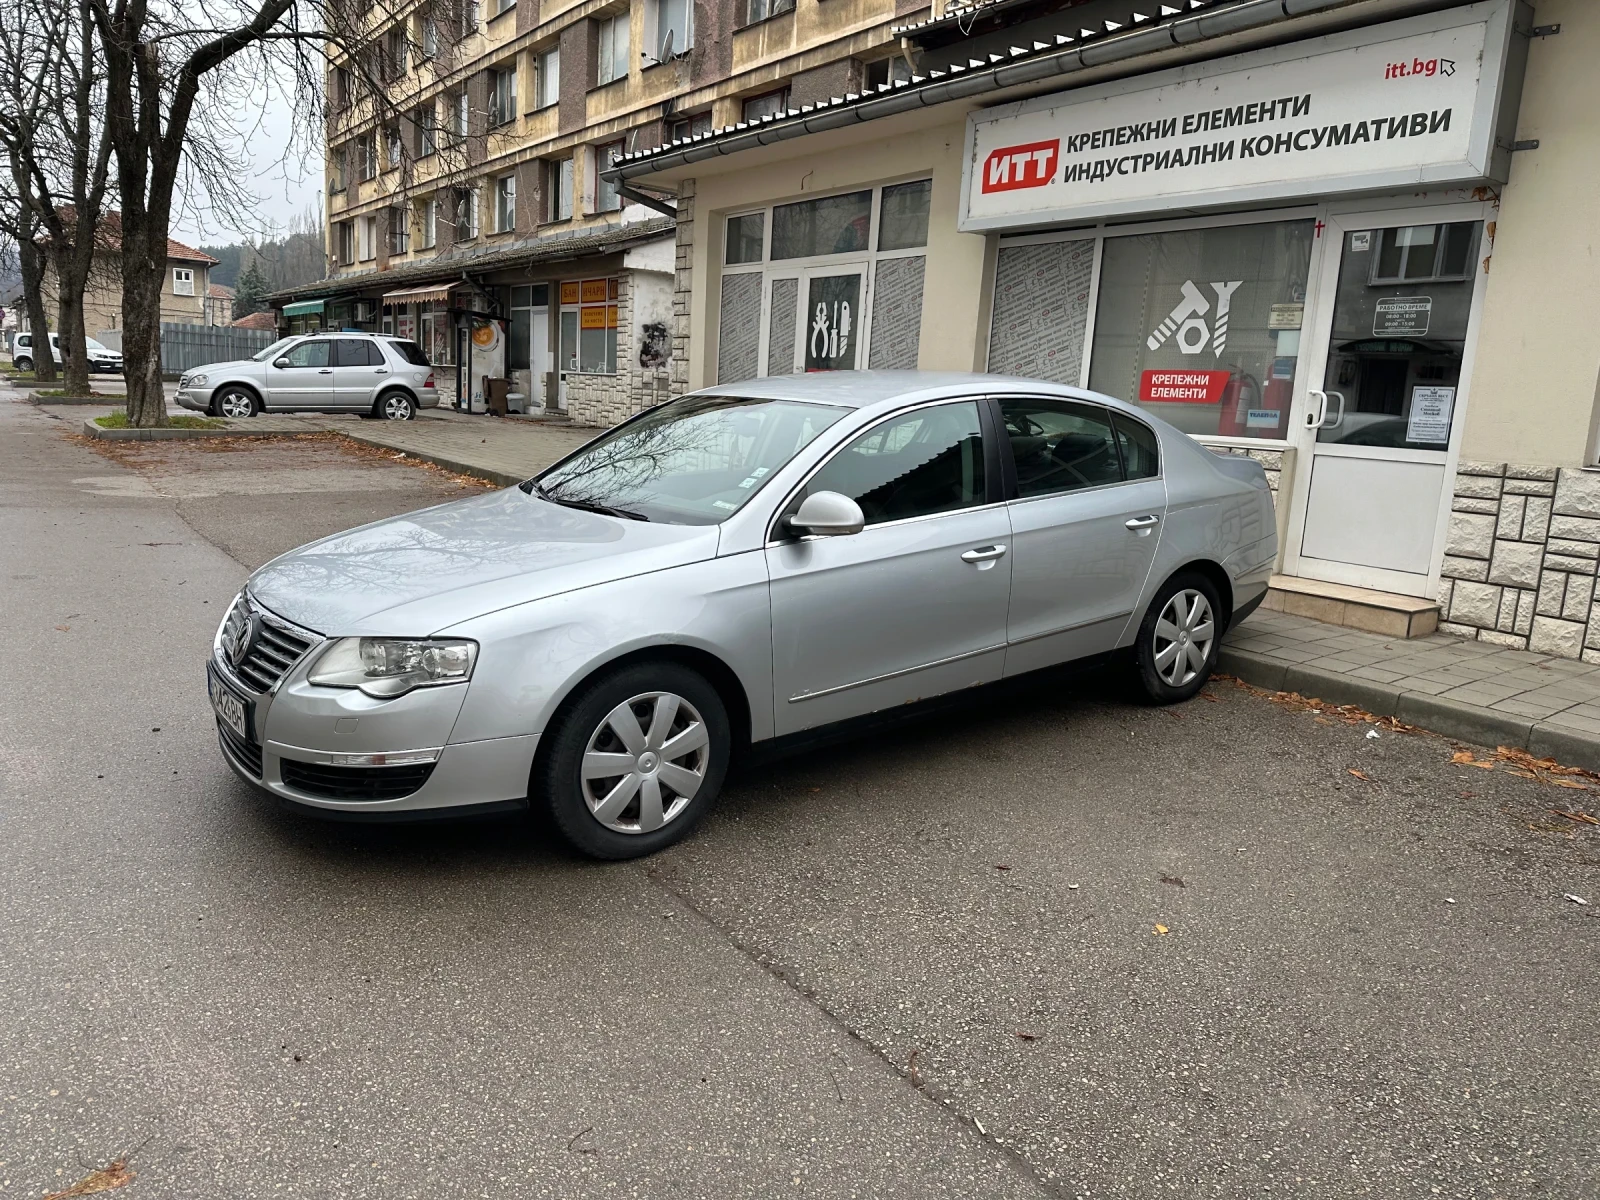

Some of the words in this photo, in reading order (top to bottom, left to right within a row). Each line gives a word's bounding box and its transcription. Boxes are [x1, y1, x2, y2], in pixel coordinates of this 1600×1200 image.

[1384, 57, 1438, 80] itt.bg
[1066, 117, 1177, 154] КРЕПЕЖНИ
[1181, 93, 1311, 135] ЕЛЕМЕНТИ
[1063, 140, 1234, 183] ИНДУСТРИАЛНИ
[1240, 108, 1452, 159] КОНСУМАТИВИ
[988, 148, 1054, 186] ИТТ
[1150, 387, 1206, 399] ЕЛЕМЕНТИ
[1151, 374, 1209, 385] КРЕПЕЖНИ
